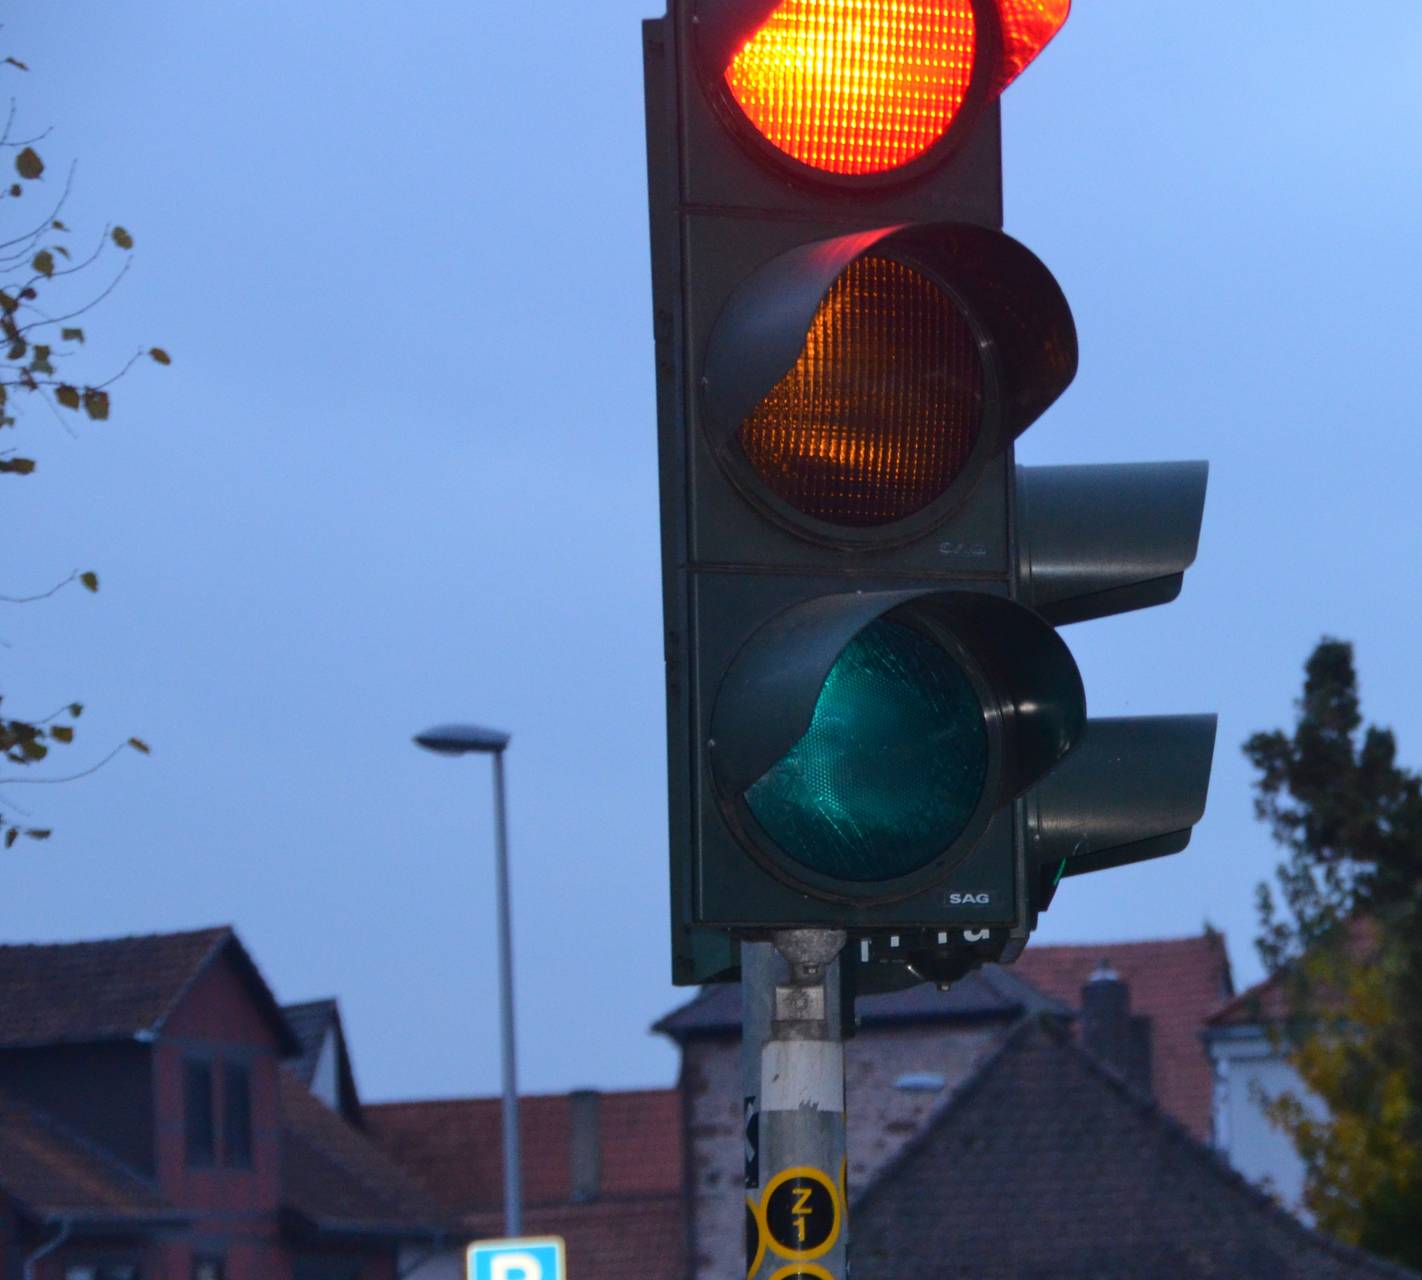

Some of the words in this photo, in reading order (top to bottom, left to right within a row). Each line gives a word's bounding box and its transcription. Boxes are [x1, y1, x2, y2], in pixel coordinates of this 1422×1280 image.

[949, 893, 990, 904] SAG
[791, 1187, 813, 1214] Z
[792, 1215, 806, 1242] 1
